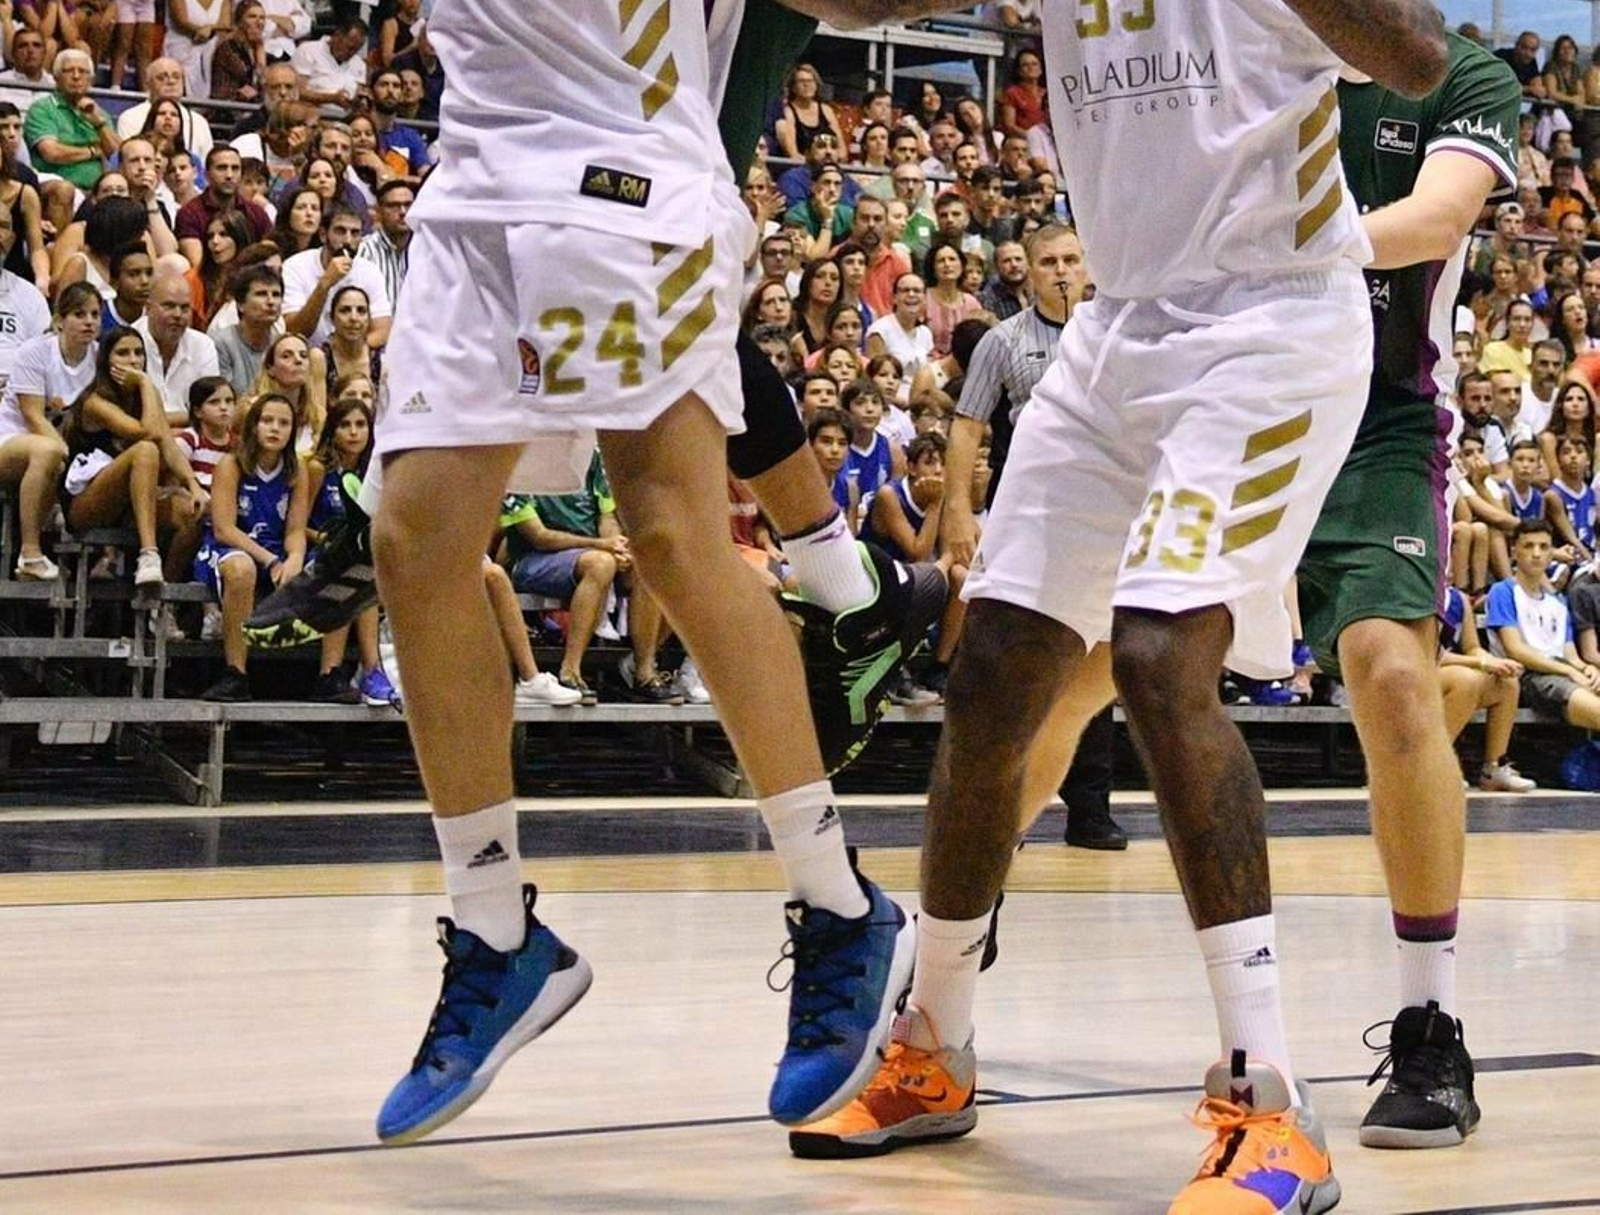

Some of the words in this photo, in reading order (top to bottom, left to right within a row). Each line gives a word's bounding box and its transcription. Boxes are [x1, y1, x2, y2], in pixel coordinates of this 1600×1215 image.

[1061, 48, 1218, 105] PLADIUM
[1134, 94, 1219, 115] GROUP
[619, 175, 647, 202] RM
[538, 300, 645, 395] 24
